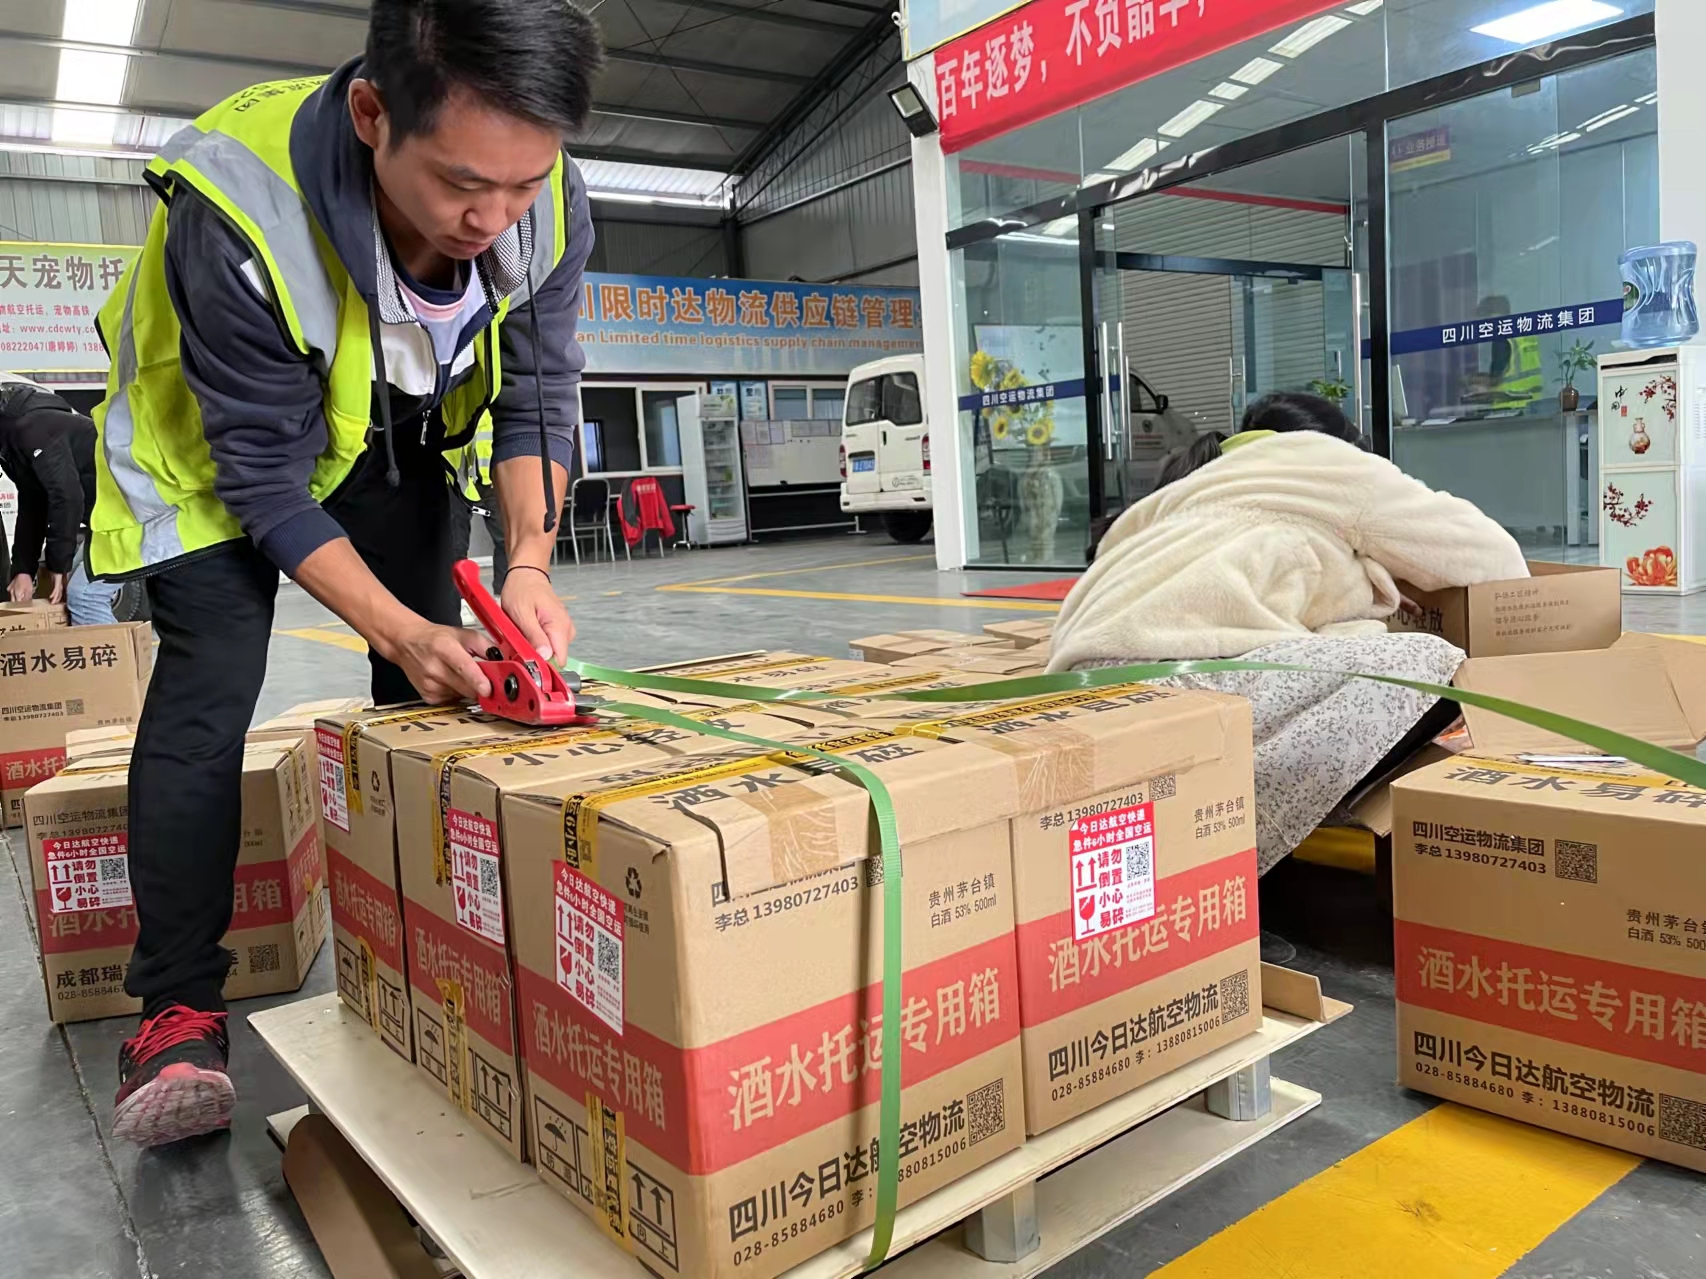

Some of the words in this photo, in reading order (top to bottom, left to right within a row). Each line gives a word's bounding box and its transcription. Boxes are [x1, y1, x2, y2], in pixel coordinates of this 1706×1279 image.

[577, 283, 922, 329] 限时达物流供应链管理
[1442, 306, 1595, 344] 四川空运物流集团
[600, 331, 660, 345] Limited
[663, 333, 697, 345] time
[701, 333, 761, 349] logistics
[764, 337, 806, 351] supply
[811, 337, 846, 349] chain
[982, 385, 1055, 406] 四川空运物流集团
[0, 643, 118, 677] 酒水易碎
[2, 702, 62, 715] 四川空运物流集团
[1444, 765, 1706, 809] 酒水易碎
[1040, 811, 1064, 832] 李总
[1067, 792, 1144, 824] 13980727403
[1080, 807, 1145, 835] 今日达航空快递
[1194, 796, 1245, 823] 贵州茅台镇
[1073, 822, 1152, 853] 急件6小时全国空运
[1195, 824, 1211, 840] 白酒
[1213, 821, 1226, 834] 53%
[1228, 814, 1246, 828] 500ml
[1412, 820, 1545, 857] 四川空运物流集团
[48, 844, 127, 860] 急件6小时全国空运
[53, 836, 119, 850] 今日达航空快递
[72, 860, 97, 871] 请勿
[1098, 848, 1123, 869] 请勿
[1414, 842, 1442, 858] 李总
[1445, 848, 1547, 875] 13980727403
[74, 872, 98, 884] 倒置
[75, 884, 99, 896] 小心
[561, 868, 617, 916] 今日达航空快递
[928, 873, 995, 908] 贵州茅台镇
[1098, 868, 1123, 889] 倒置
[77, 897, 101, 909] 易碎
[556, 880, 622, 936] 急件6小时全国空运
[714, 908, 750, 932] 李总
[752, 876, 859, 922] 13980727403
[930, 907, 952, 929] 白酒
[955, 902, 971, 919] 53%
[974, 893, 997, 914] 500ml
[1099, 888, 1124, 908] 小心
[574, 913, 595, 942] 请勿
[1100, 907, 1124, 929] 易碎
[1048, 875, 1246, 993] 酒水托运专用箱
[1627, 926, 1654, 943] 白酒
[1659, 932, 1681, 947] 53%
[574, 937, 595, 965] 倒置
[56, 964, 130, 989] 成都瑞
[575, 959, 595, 985] 小心
[576, 979, 596, 1009] 易碎
[1416, 945, 1706, 1050] 酒水托运专用箱
[1048, 983, 1219, 1082] 四川今日达航空物流
[532, 998, 667, 1131] 酒水托运专用箱
[1052, 1056, 1131, 1102] 028-85884680
[1156, 1015, 1221, 1054] 13880815006
[1413, 1030, 1655, 1118] 四川今日达航空物流
[1415, 1061, 1514, 1098] 028-85884680
[1552, 1099, 1656, 1136] 13880815006
[733, 1199, 844, 1266] 028-85884680
[896, 1138, 967, 1183] 880815006
